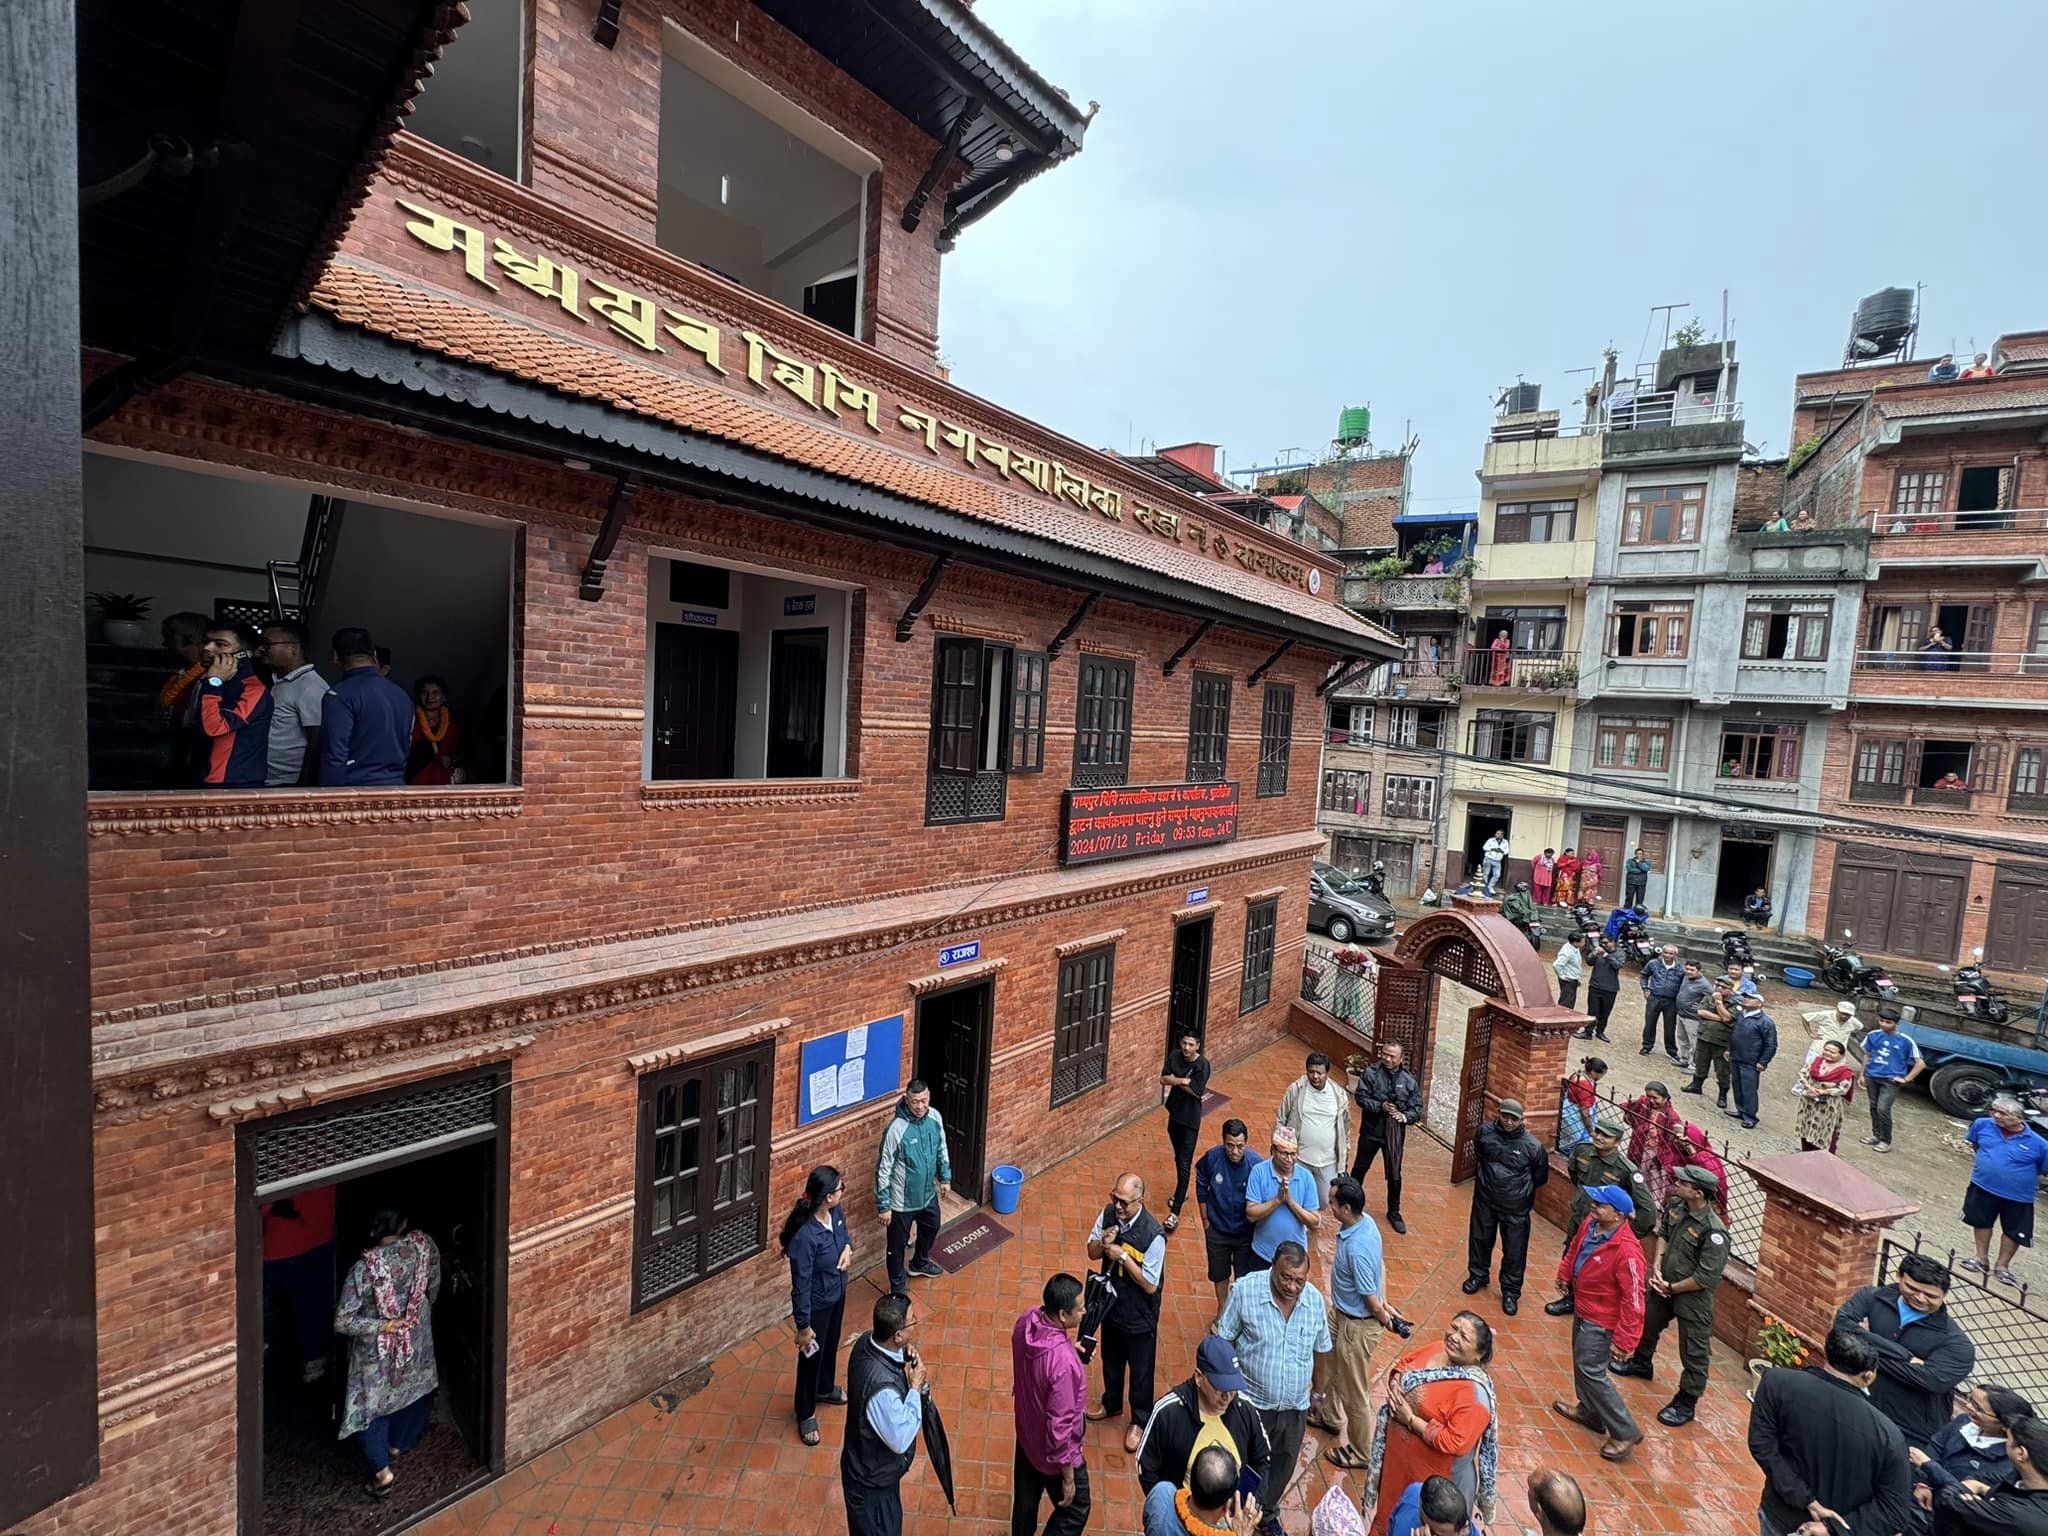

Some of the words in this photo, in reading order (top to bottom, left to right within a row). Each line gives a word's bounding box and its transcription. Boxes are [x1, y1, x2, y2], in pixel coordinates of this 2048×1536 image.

[1100, 790, 1119, 807] थिमि
[1119, 788, 1156, 806] नगरपालिका
[1070, 833, 1128, 855] 2024/07/12
[1135, 831, 1165, 846] Friday
[943, 1224, 990, 1255] WELCOME
